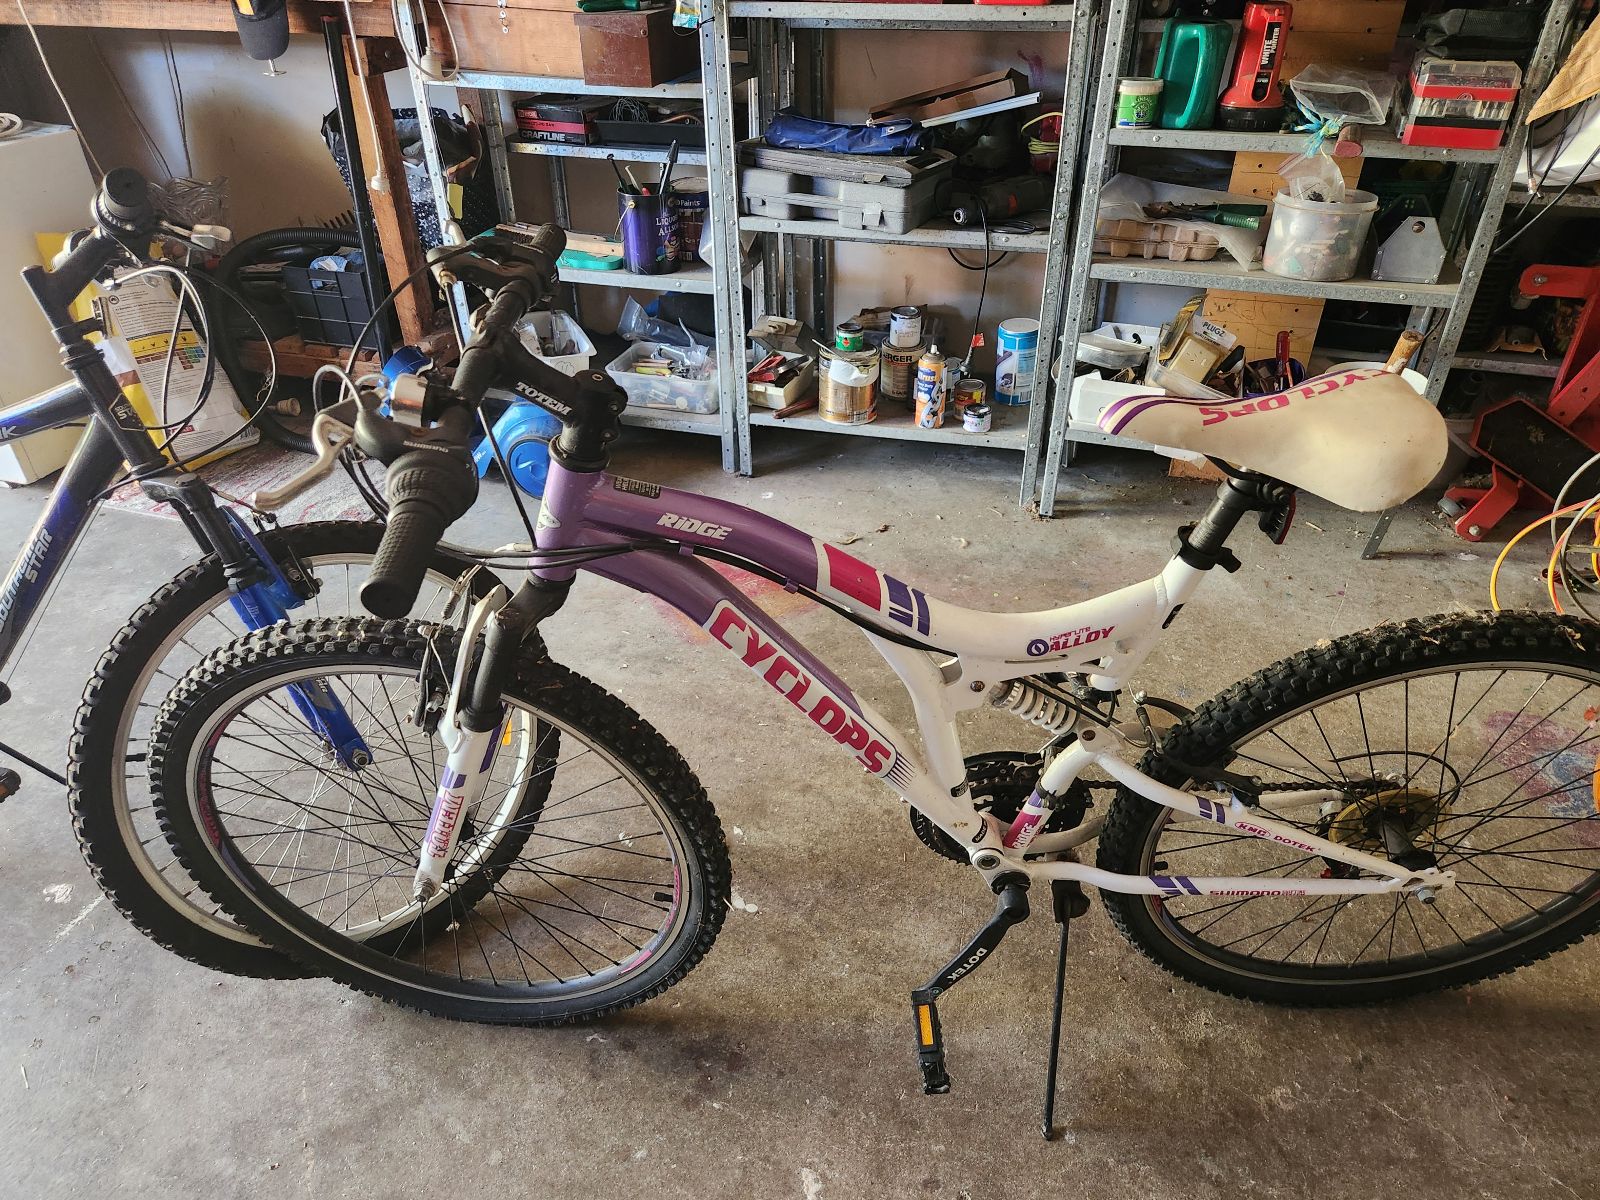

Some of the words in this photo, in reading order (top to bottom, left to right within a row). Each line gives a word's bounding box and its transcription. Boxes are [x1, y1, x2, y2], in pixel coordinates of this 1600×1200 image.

[1261, 39, 1272, 65] WHITE
[1269, 27, 1280, 54] POINTER
[521, 130, 566, 142] CRAFTLINE
[1202, 321, 1226, 338] PLUGZ
[515, 381, 573, 416] TOTEM
[656, 512, 733, 541] RIDGE
[24, 528, 53, 584] STAR
[1048, 625, 1116, 653] ALLOY
[708, 606, 892, 774] CYCLOPS
[1273, 835, 1317, 852] DOTEK
[946, 947, 988, 981] DOTEK
